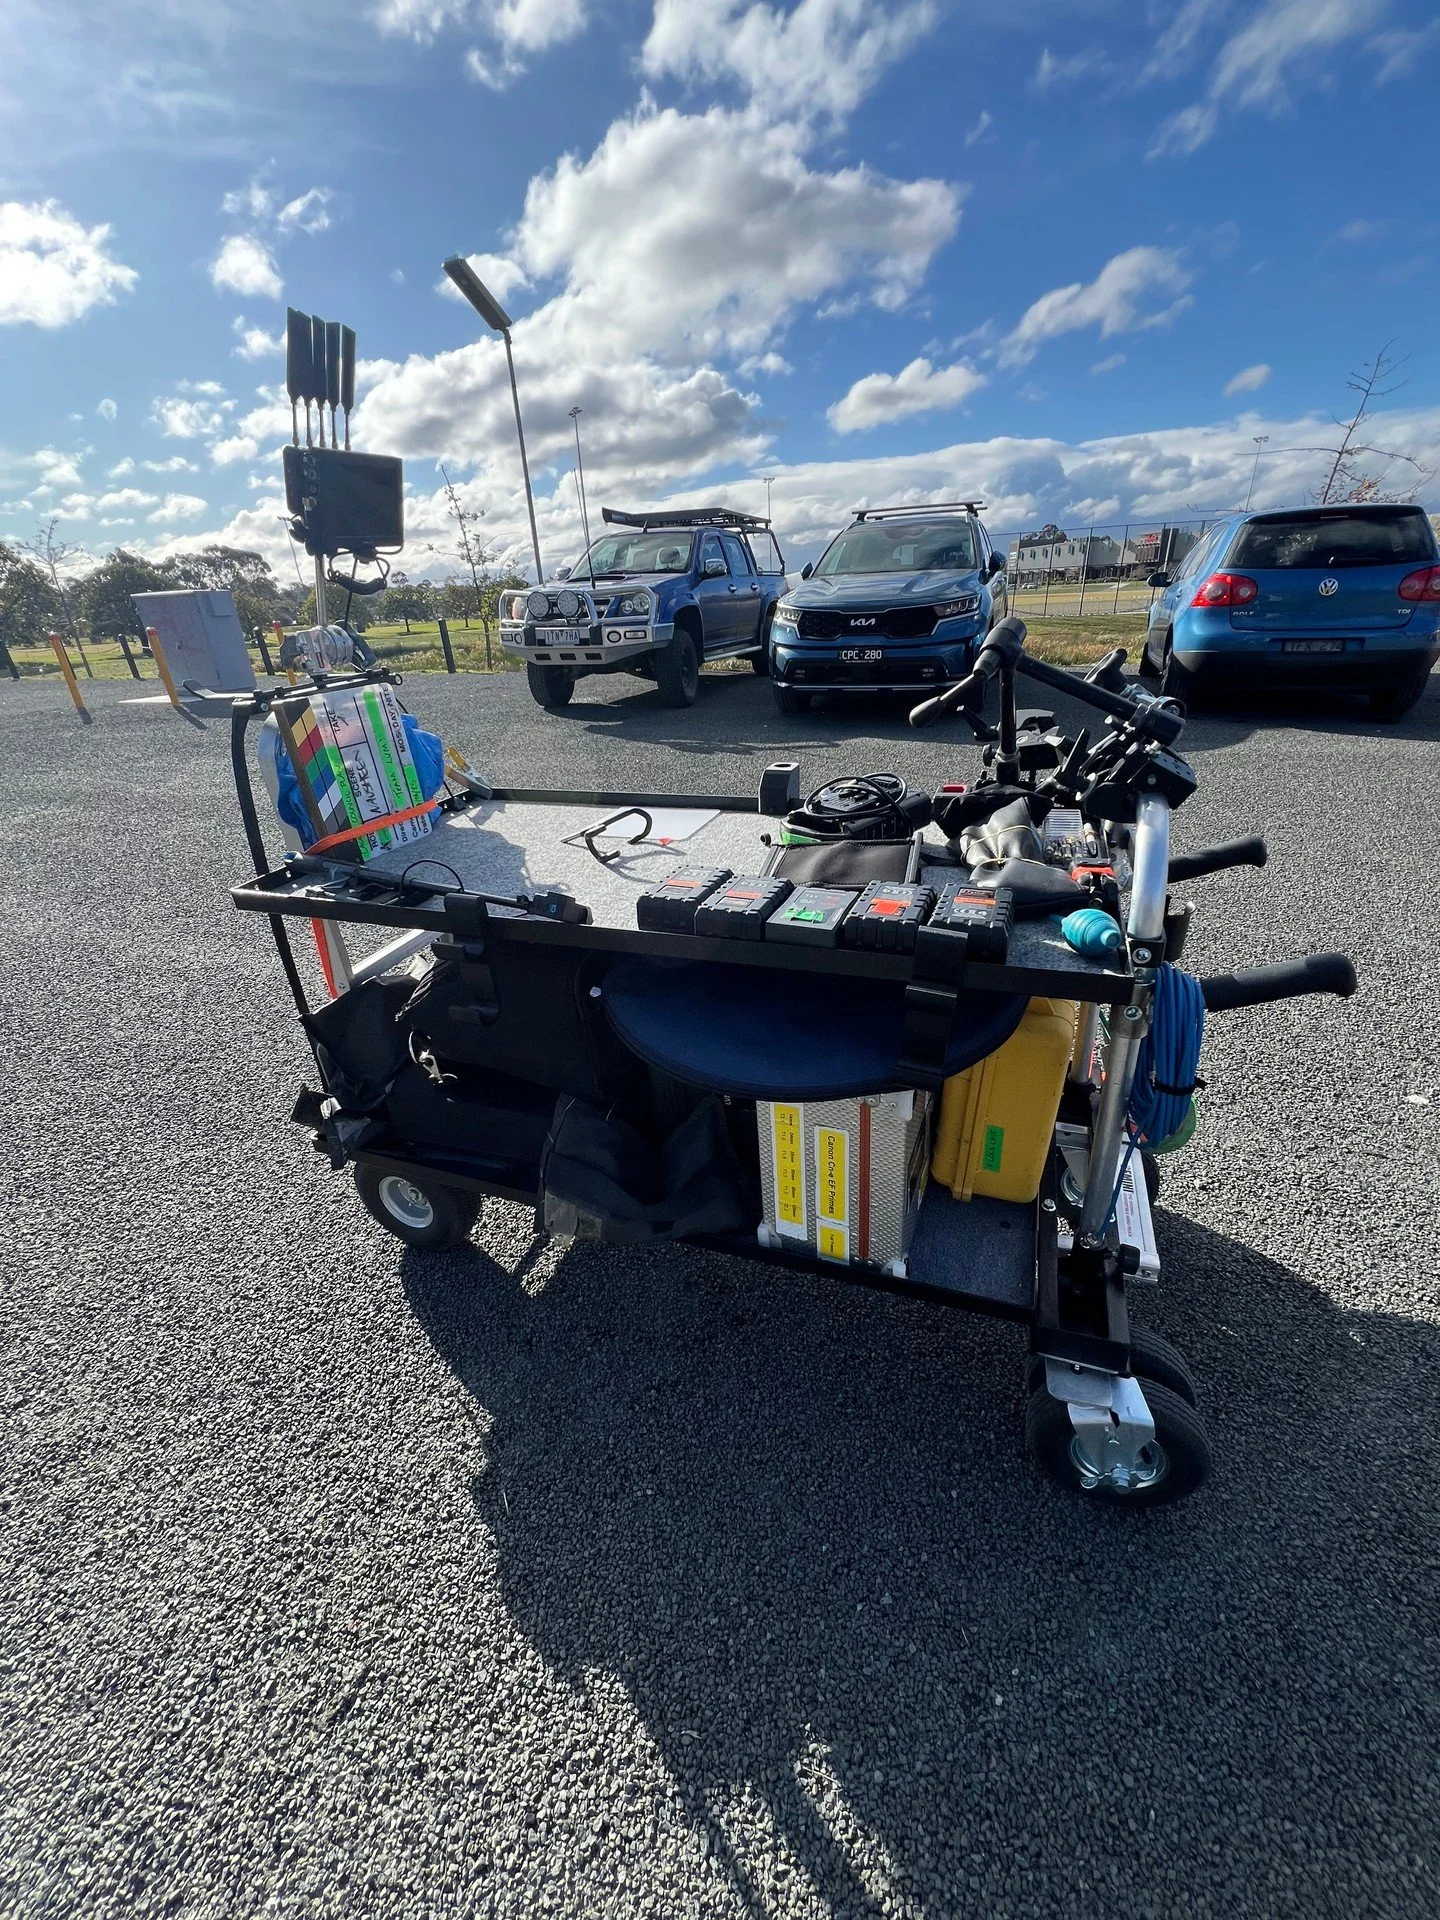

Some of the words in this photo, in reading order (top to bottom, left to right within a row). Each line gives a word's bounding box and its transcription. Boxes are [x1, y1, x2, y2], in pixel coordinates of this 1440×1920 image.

[850, 618, 876, 626] KIA
[842, 650, 859, 660] CPC
[864, 650, 882, 660] 280
[328, 709, 341, 734] TAKE
[396, 731, 406, 753] MOS
[348, 767, 362, 798] SCENE
[390, 772, 403, 799] TEAM
[345, 791, 358, 824] COUNCIL
[828, 1136, 836, 1160] Canon
[828, 1161, 836, 1178] Cn-e
[828, 1180, 836, 1190] EF
